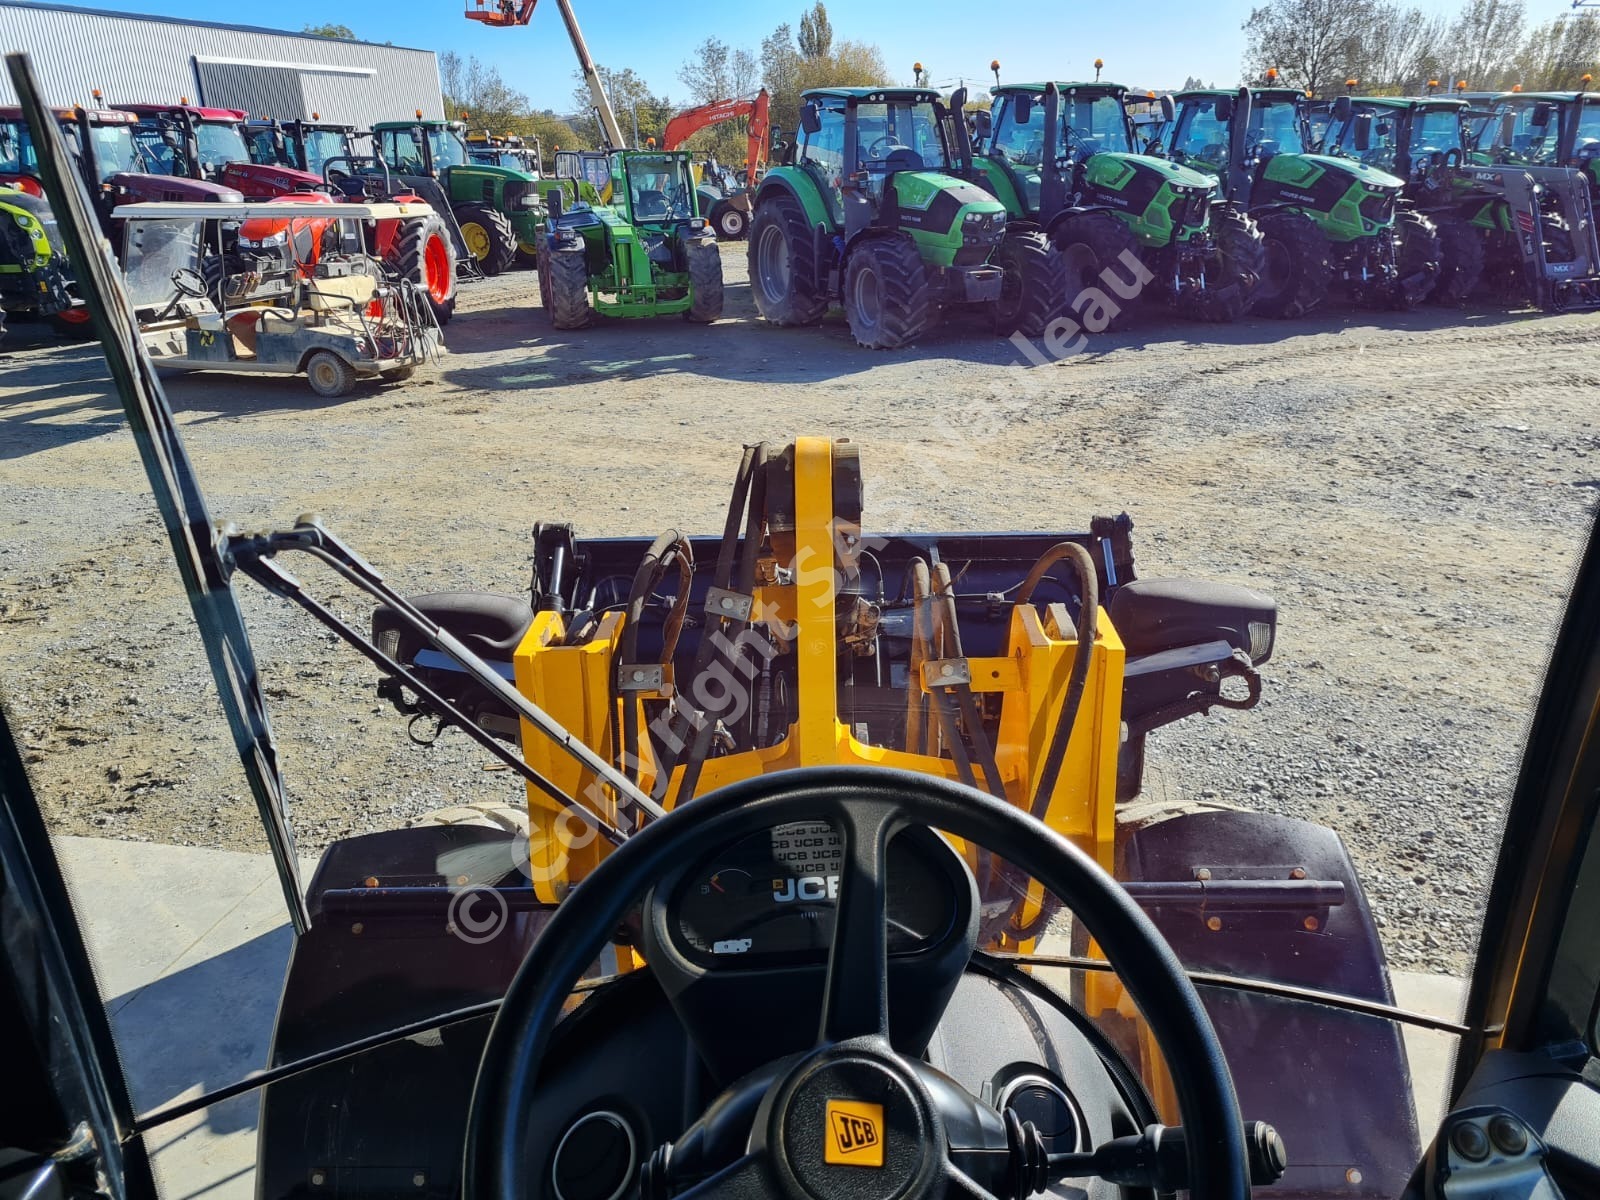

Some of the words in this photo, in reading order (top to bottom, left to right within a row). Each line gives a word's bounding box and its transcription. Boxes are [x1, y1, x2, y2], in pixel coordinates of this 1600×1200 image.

[708, 111, 734, 121] HITACHI
[1476, 172, 1495, 181] MX
[1553, 264, 1569, 273] MX
[769, 840, 790, 849] CB
[794, 838, 824, 848] JCB
[778, 851, 808, 861] JCB
[812, 849, 841, 860] JCB
[796, 863, 826, 873] JCB
[840, 1115, 875, 1149] JCB
